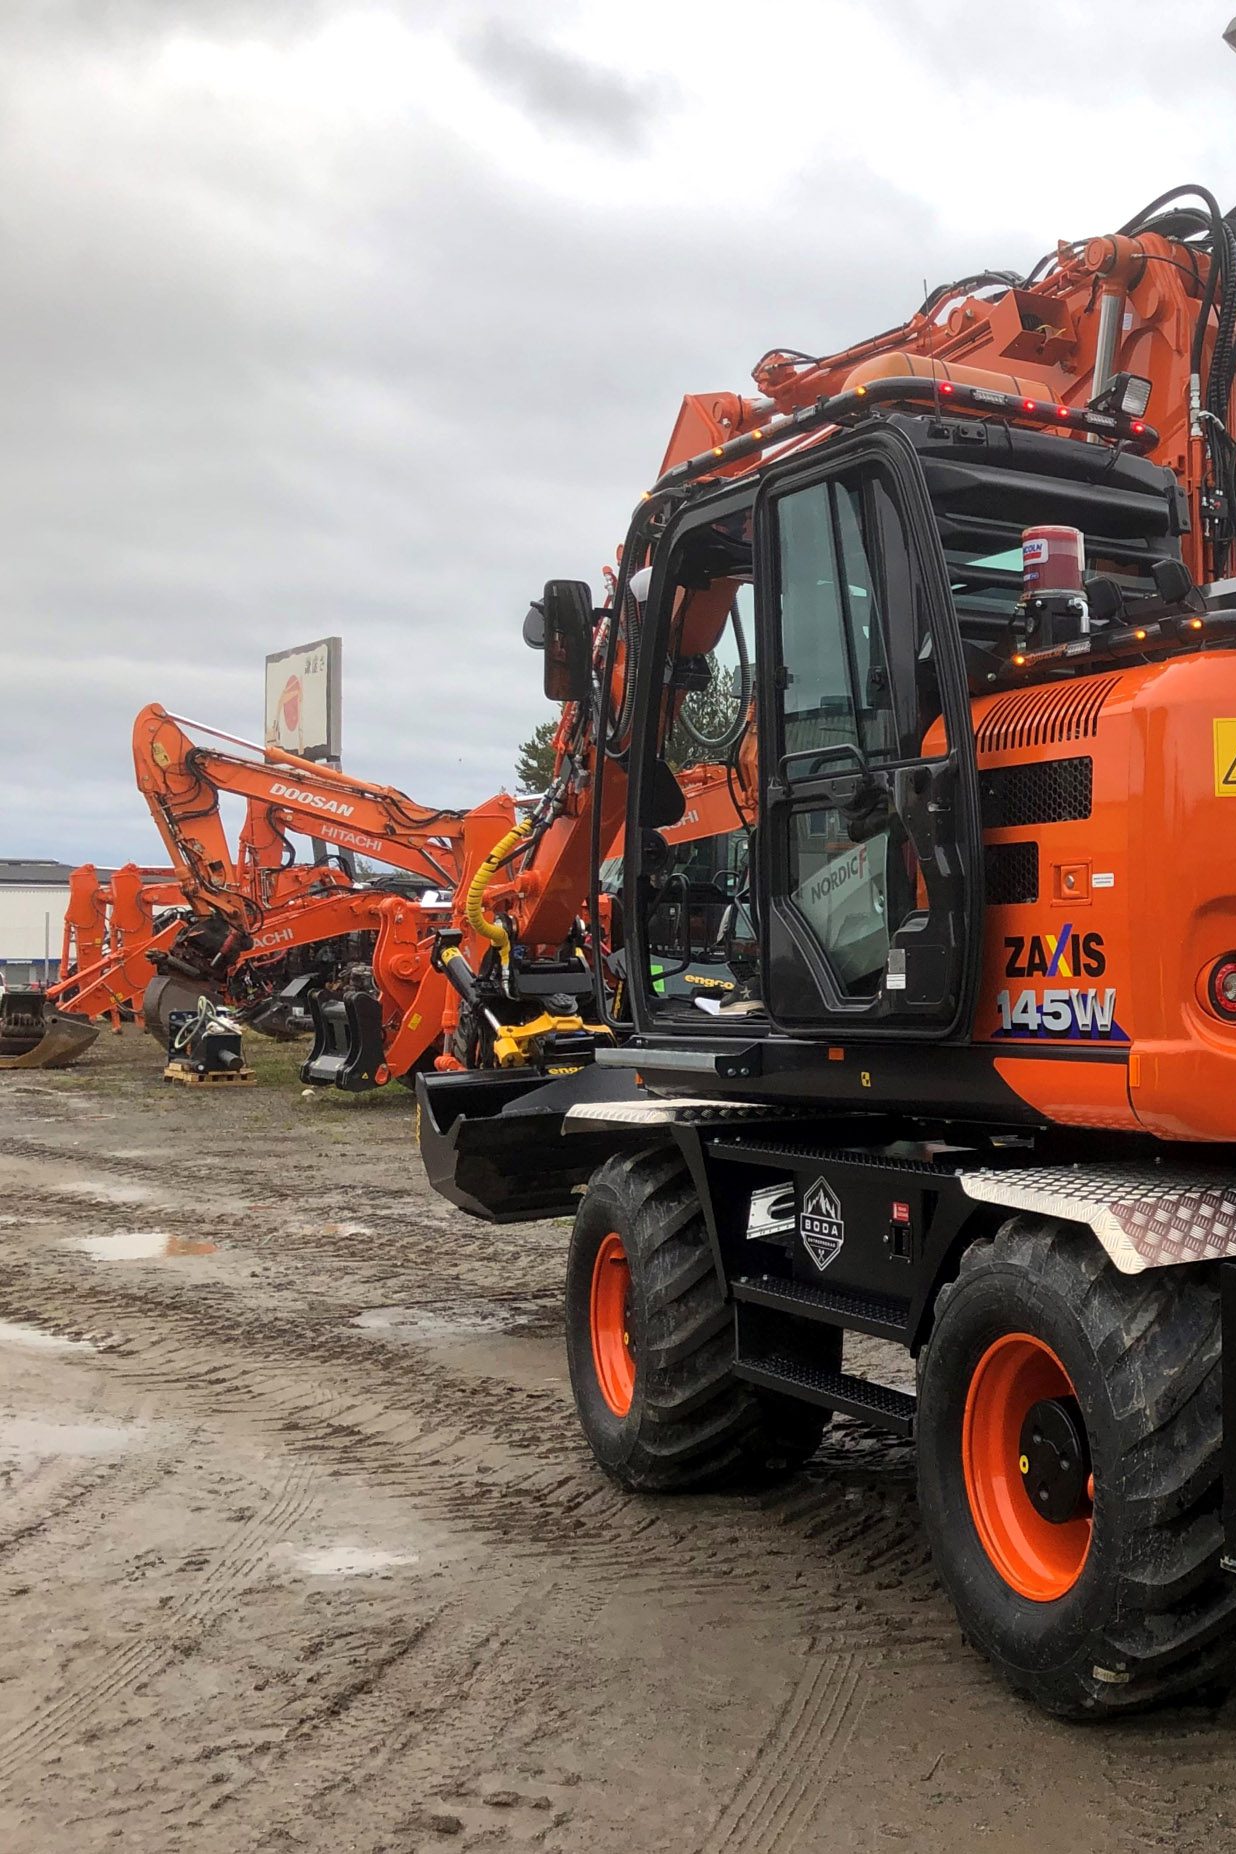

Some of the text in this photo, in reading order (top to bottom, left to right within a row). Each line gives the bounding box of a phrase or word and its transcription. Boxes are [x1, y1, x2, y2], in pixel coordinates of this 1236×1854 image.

[270, 783, 354, 817] DOOSAN
[321, 825, 383, 851] HITACHI
[252, 928, 294, 950] ACHI
[1004, 923, 1106, 978] ZAXIS
[997, 988, 1117, 1032] 145W
[805, 1219, 838, 1236] BODA
